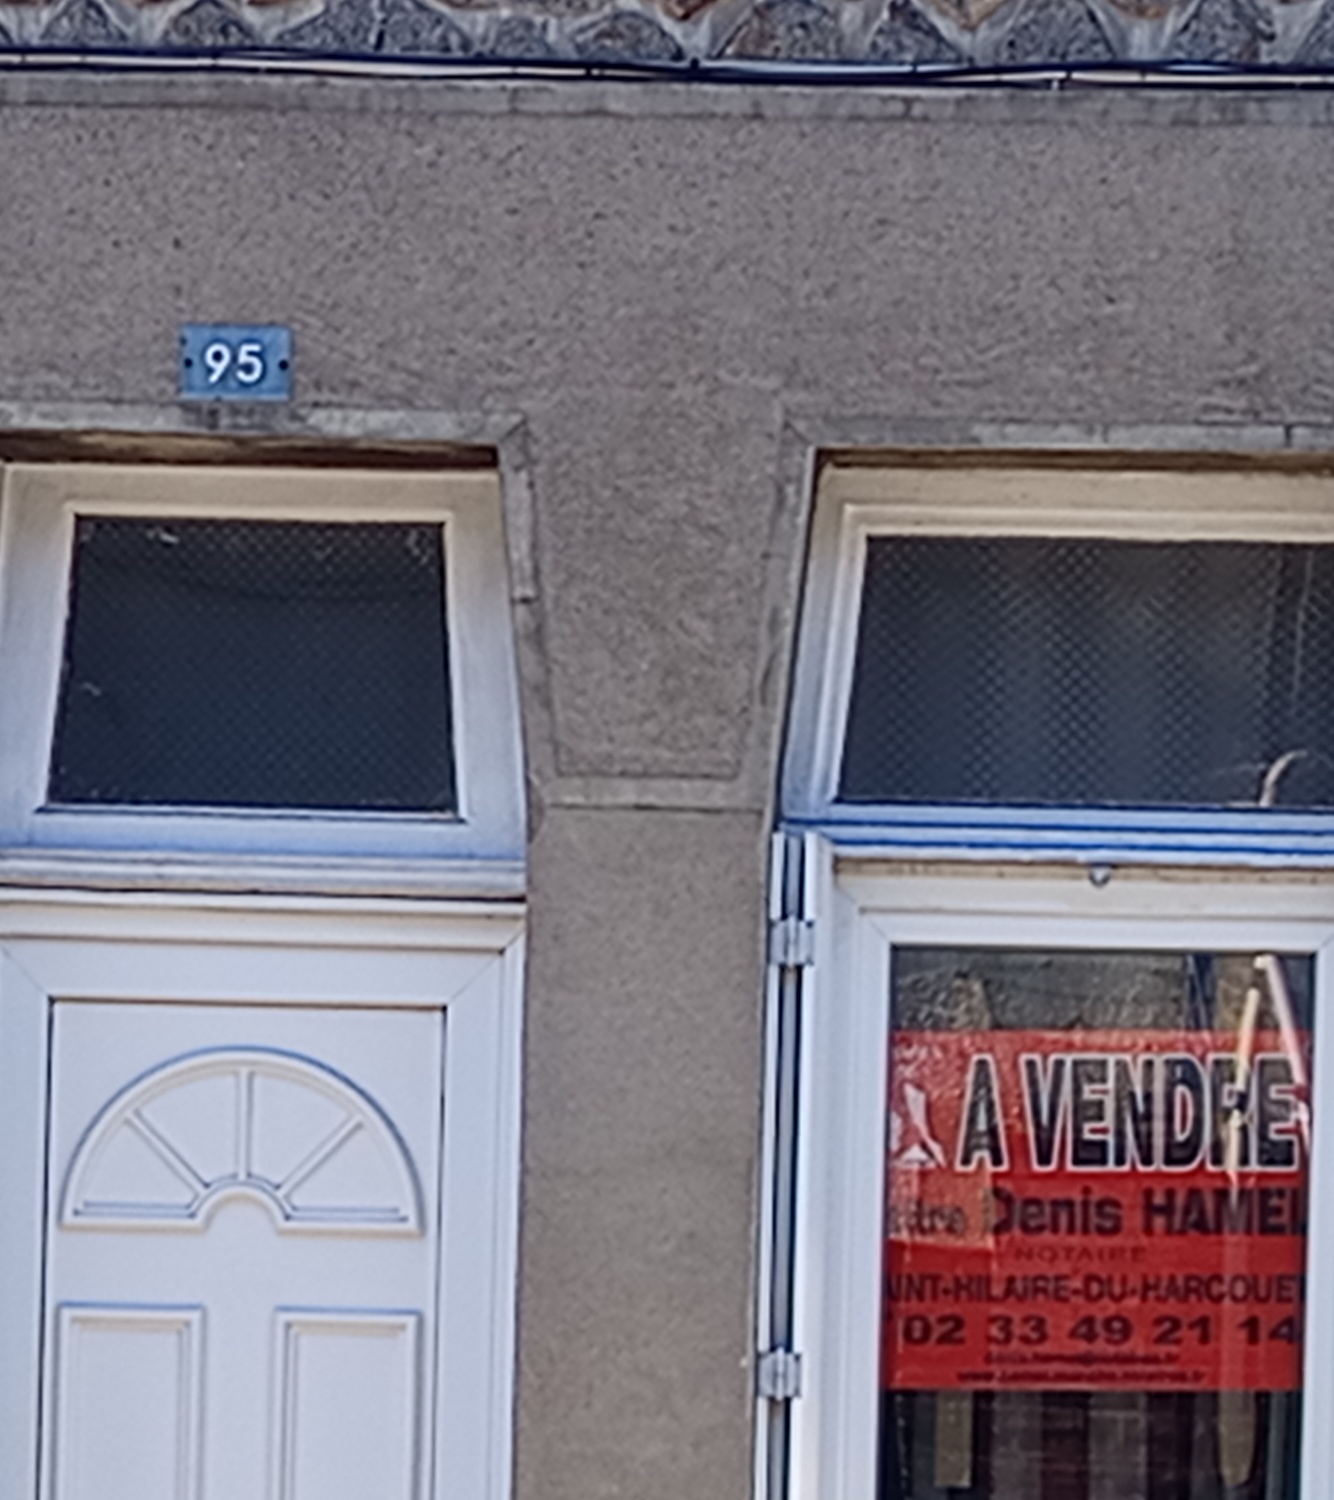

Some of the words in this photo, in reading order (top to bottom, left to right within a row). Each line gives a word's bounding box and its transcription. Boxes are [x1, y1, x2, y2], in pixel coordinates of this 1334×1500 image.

[204, 342, 264, 384] 95
[954, 1053, 1009, 1172] A
[1018, 1053, 1299, 1172] VENDRE
[982, 1185, 1124, 1237] Denis
[1013, 1245, 1147, 1264] NOTAIRE
[902, 1313, 967, 1346] 02
[985, 1313, 1050, 1346] 33
[1068, 1313, 1134, 1346] 49
[1152, 1313, 1213, 1346] 21
[1237, 1313, 1300, 1346] 14
